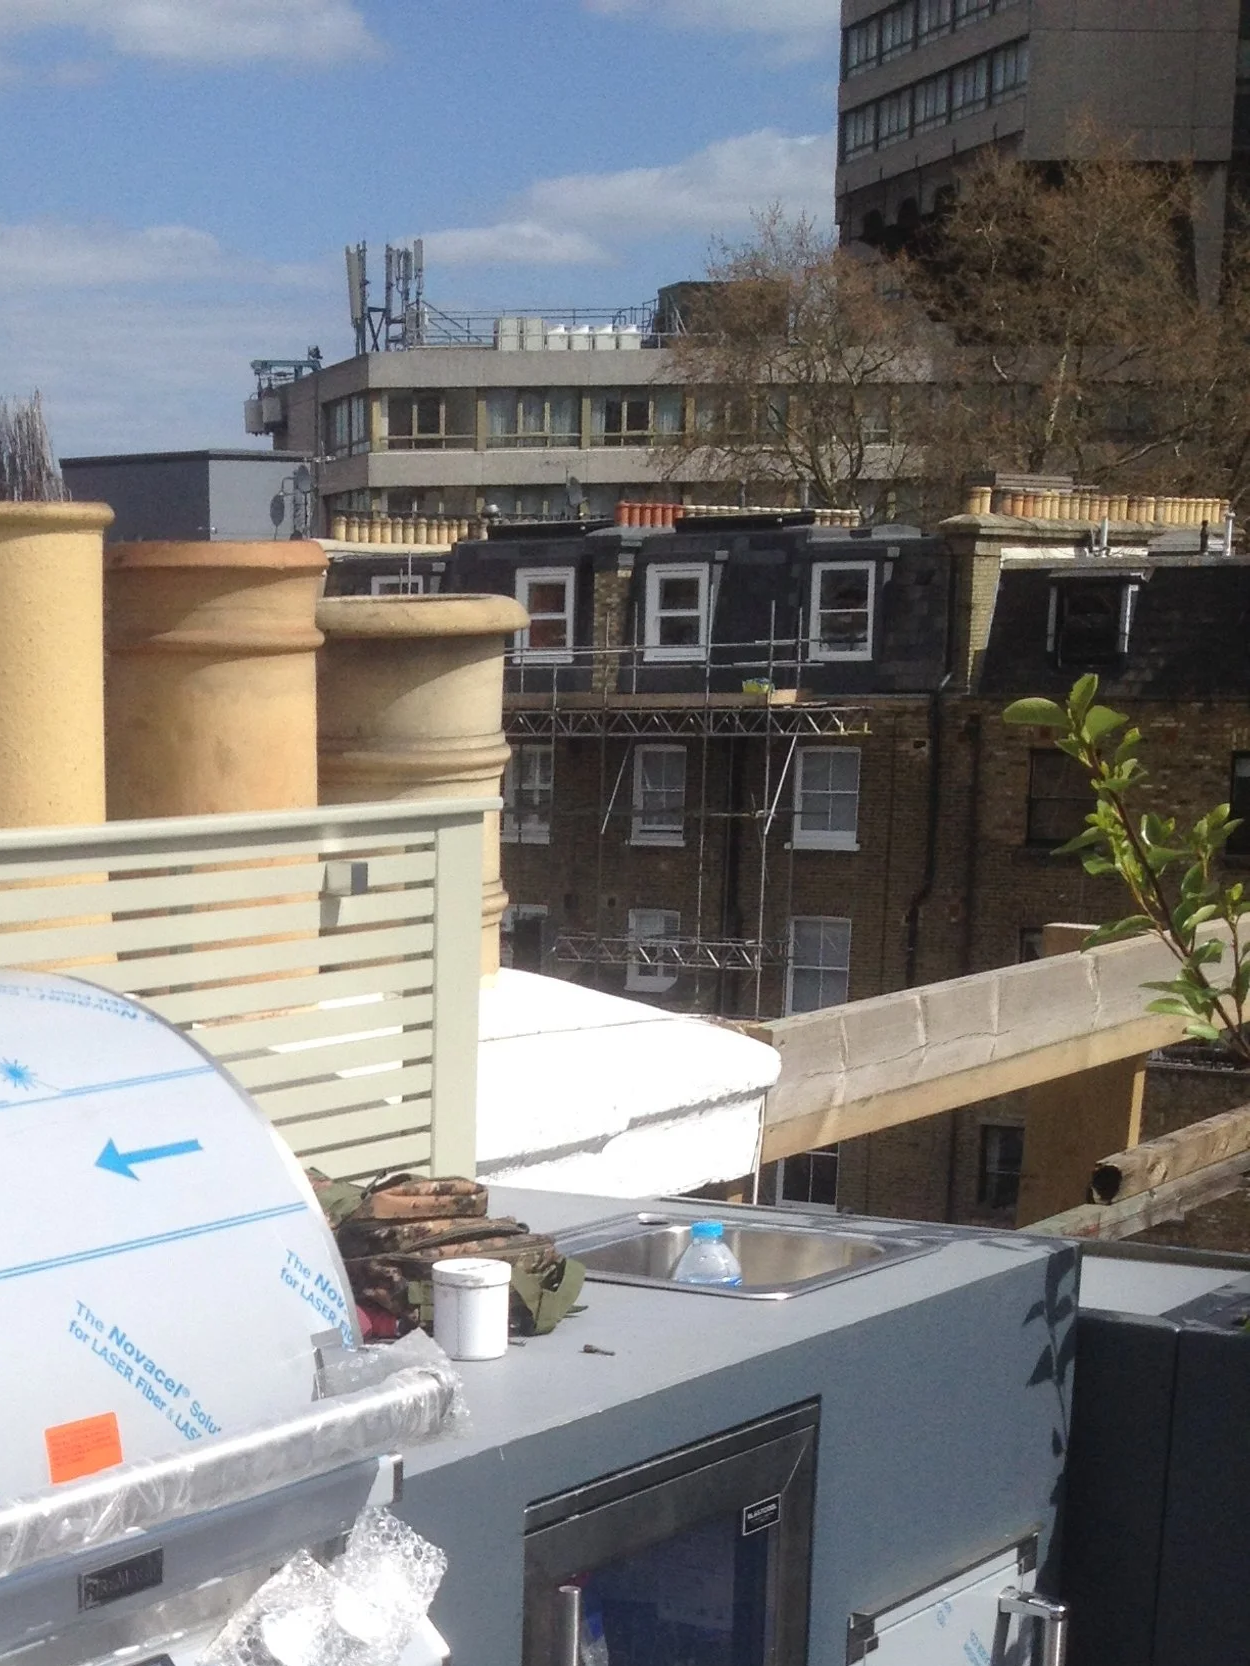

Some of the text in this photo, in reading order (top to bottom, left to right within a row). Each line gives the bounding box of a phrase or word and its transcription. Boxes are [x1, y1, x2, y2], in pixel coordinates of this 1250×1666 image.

[286, 1248, 311, 1279] The
[76, 1300, 104, 1333] The
[280, 1267, 299, 1289] for
[300, 1284, 337, 1326] LASER
[69, 1319, 90, 1342] for
[91, 1338, 134, 1384] LASER
[135, 1376, 166, 1411] Fiber
